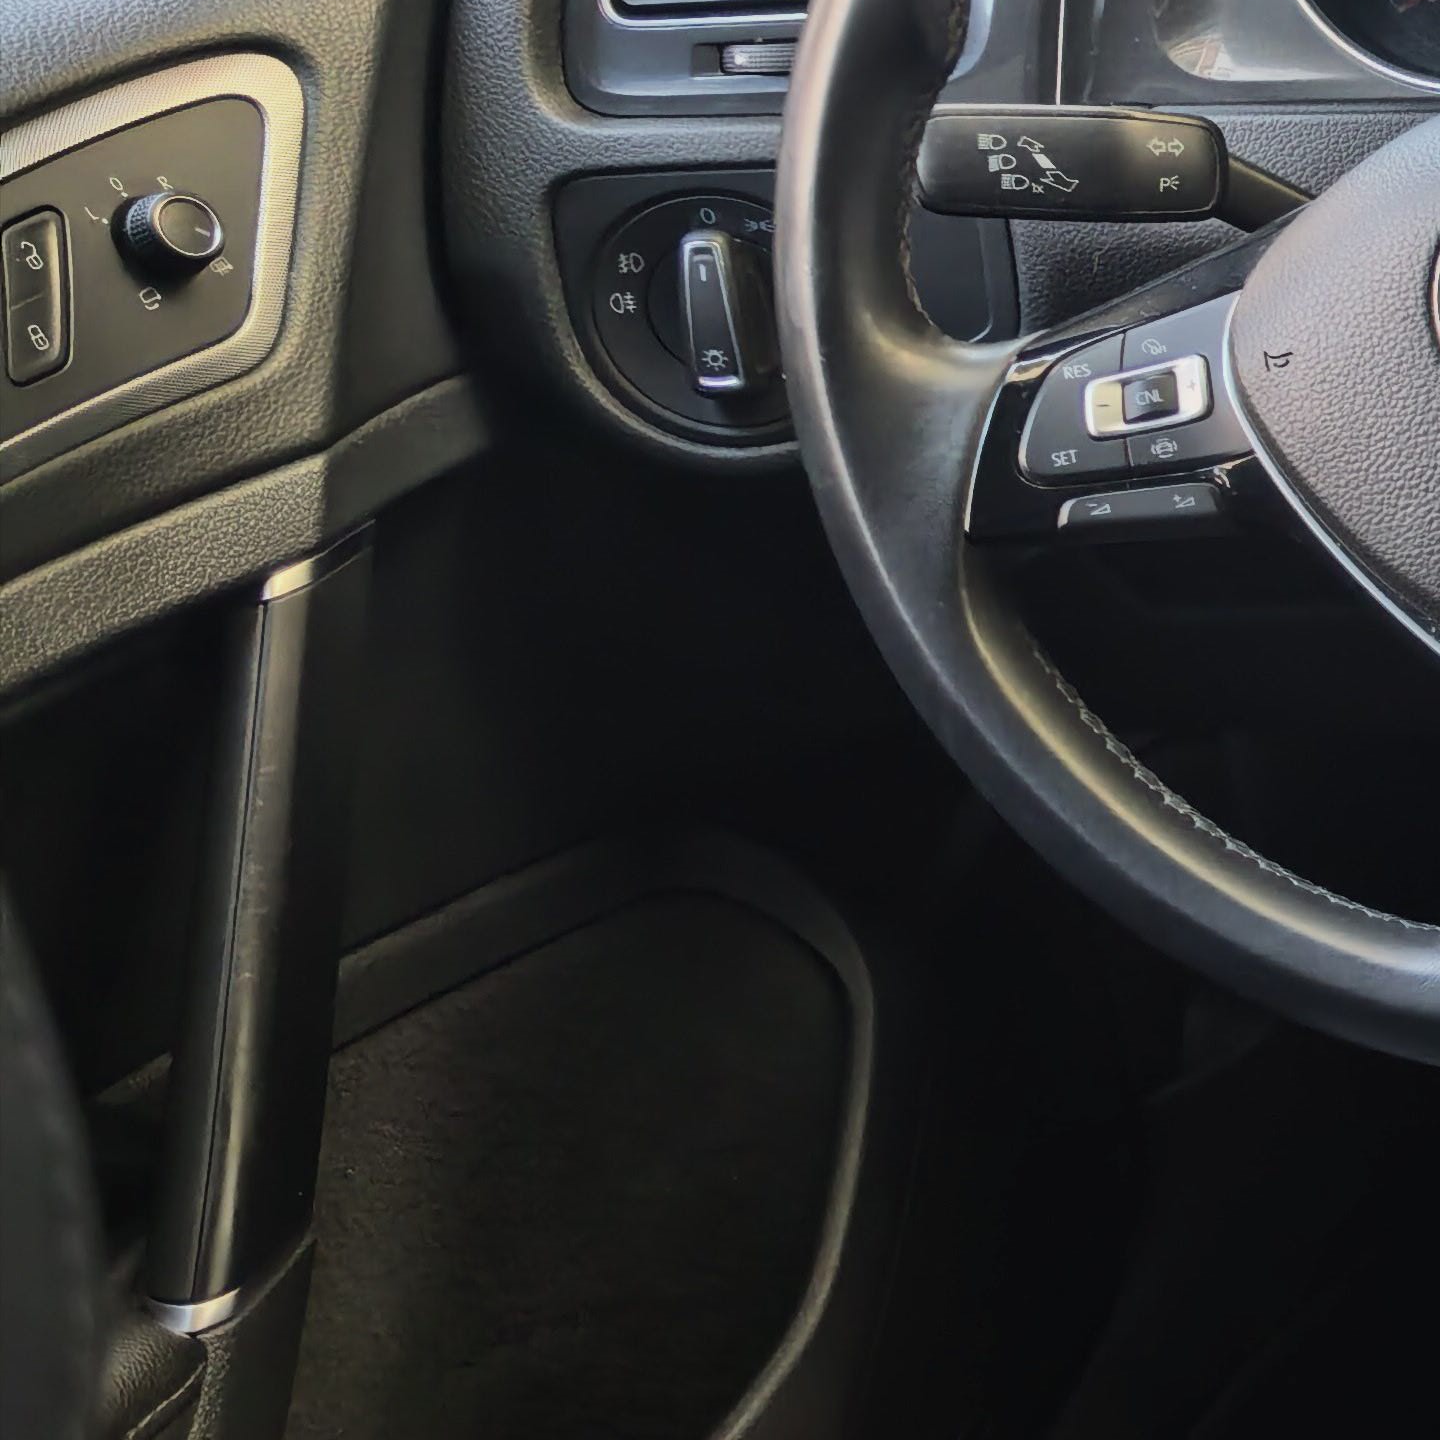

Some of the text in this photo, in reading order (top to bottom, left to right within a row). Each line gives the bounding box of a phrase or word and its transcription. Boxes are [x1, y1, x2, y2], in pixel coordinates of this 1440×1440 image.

[156, 175, 174, 190] R
[1062, 363, 1093, 380] RES
[1135, 389, 1165, 407] CNL
[1051, 448, 1079, 468] SET
